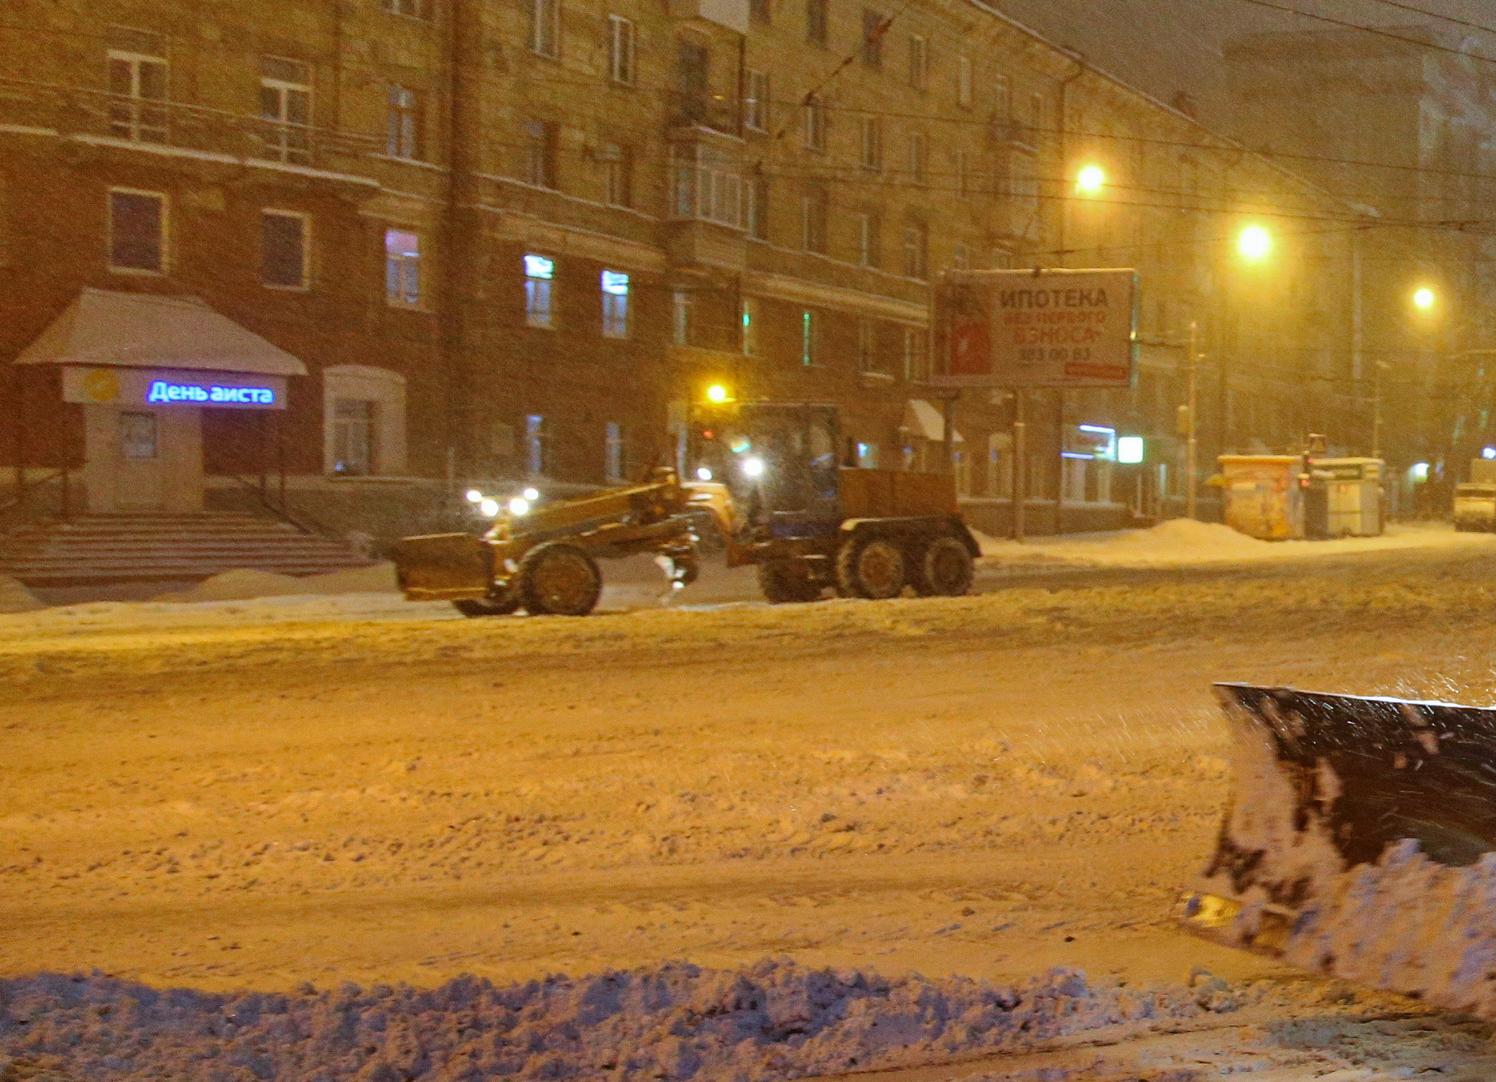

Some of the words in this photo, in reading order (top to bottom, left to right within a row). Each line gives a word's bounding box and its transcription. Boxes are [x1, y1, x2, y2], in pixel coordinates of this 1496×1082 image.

[1000, 288, 1109, 308] ИПОТЕКА
[150, 380, 208, 403] День
[210, 384, 274, 404] аиста
